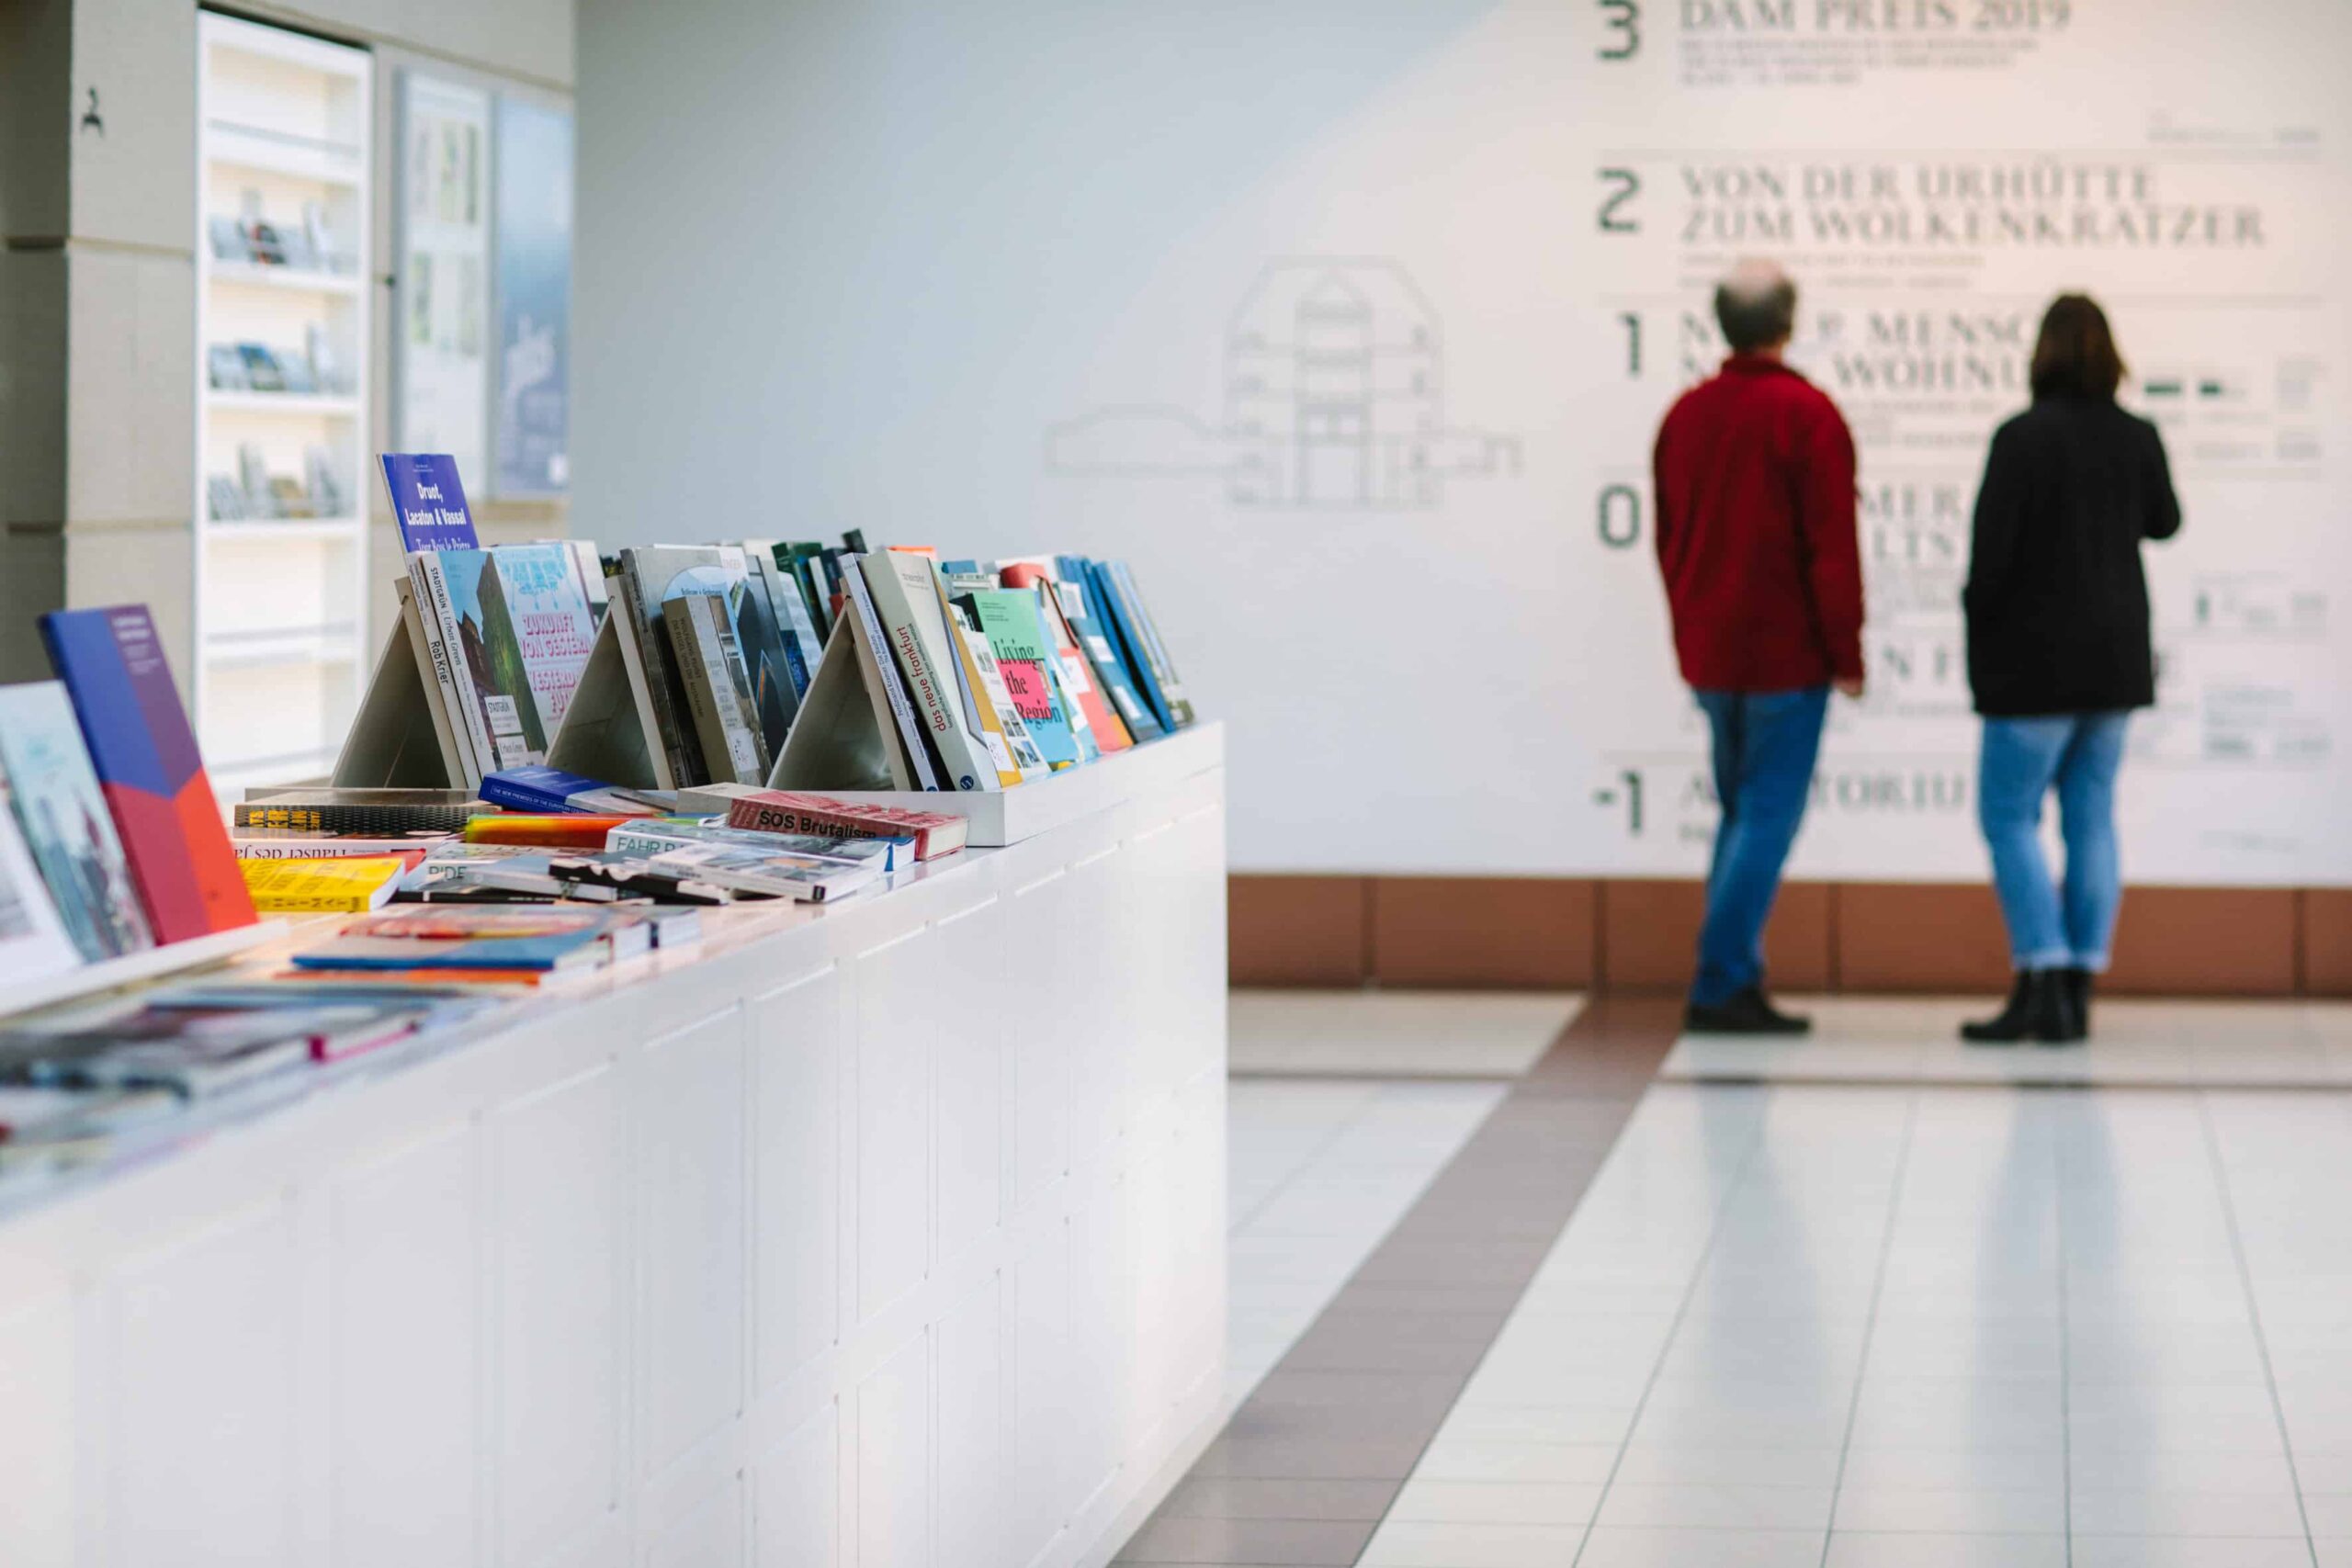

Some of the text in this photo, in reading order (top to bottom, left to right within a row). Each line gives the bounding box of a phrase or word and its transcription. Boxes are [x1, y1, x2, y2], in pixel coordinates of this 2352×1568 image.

[1597, 0, 1640, 61] 3
[1680, 0, 2071, 31] DAM PREIS 2019
[1680, 154, 2154, 201] VON DER URHÜTTE
[1597, 166, 1641, 232] 2
[1680, 208, 2266, 245] ZUM WOLKENKRATZER
[1618, 312, 1642, 378] 1
[1834, 354, 2030, 390] WOHNU
[416, 482, 444, 503] Druot,
[404, 507, 467, 526] Lacaton & Vassal
[430, 566, 448, 609] STADTGRÜN
[431, 640, 449, 684] Rob Krier
[897, 626, 923, 678] frankfurt
[993, 638, 1039, 671] Living
[920, 678, 936, 707] neue
[1005, 670, 1029, 694] the
[933, 709, 946, 731] das
[1013, 699, 1063, 730] Region
[1591, 771, 1644, 837] -1
[759, 809, 878, 840] SOS Brutalism
[616, 836, 661, 852] FAHR
